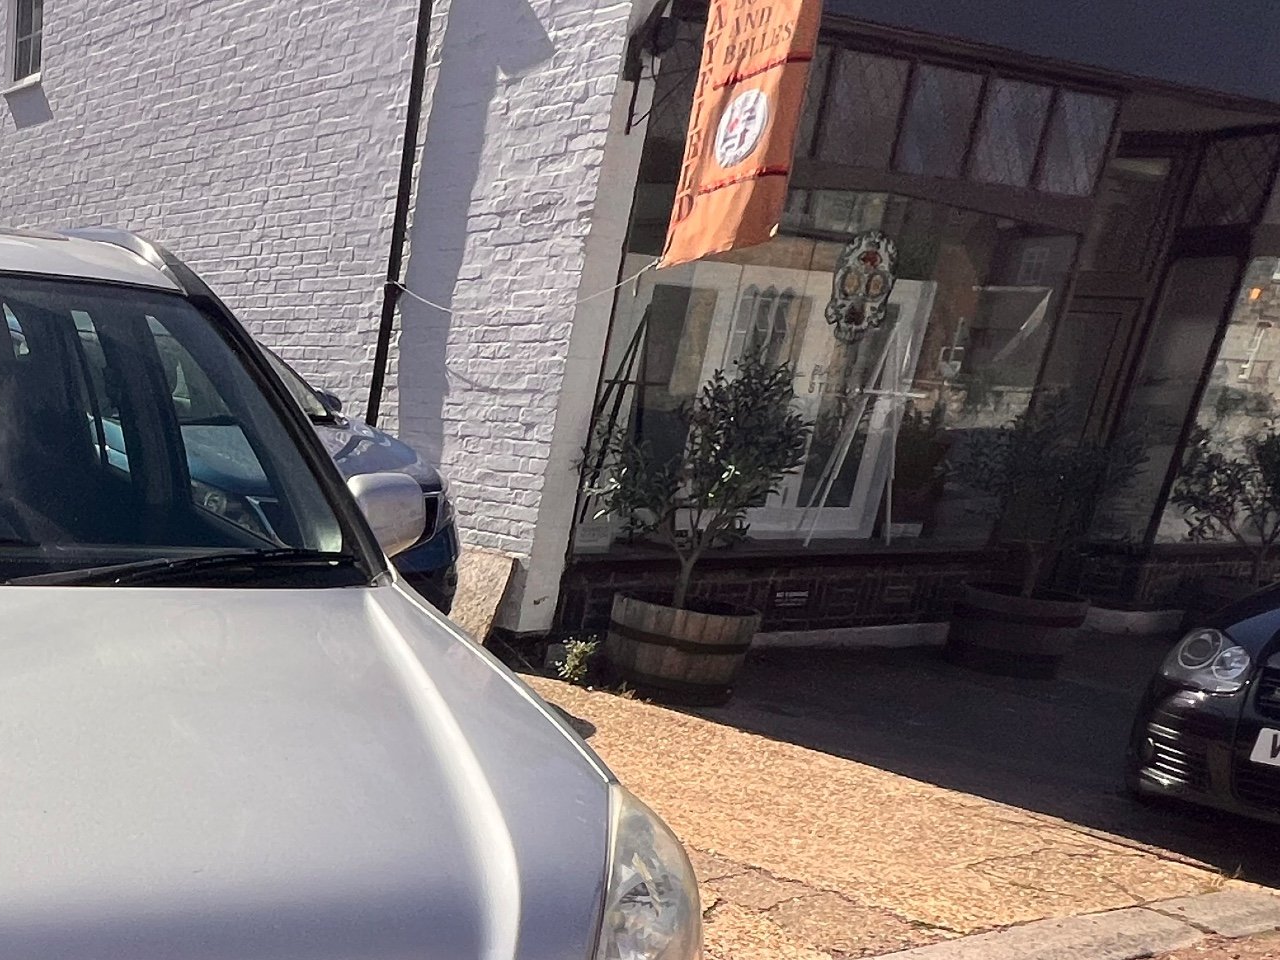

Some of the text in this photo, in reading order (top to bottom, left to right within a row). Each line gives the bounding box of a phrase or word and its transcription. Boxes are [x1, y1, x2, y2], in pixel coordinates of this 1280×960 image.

[723, 19, 794, 65] BELLES
[728, 6, 773, 38] AND
[672, 0, 727, 225] AYFIELD
